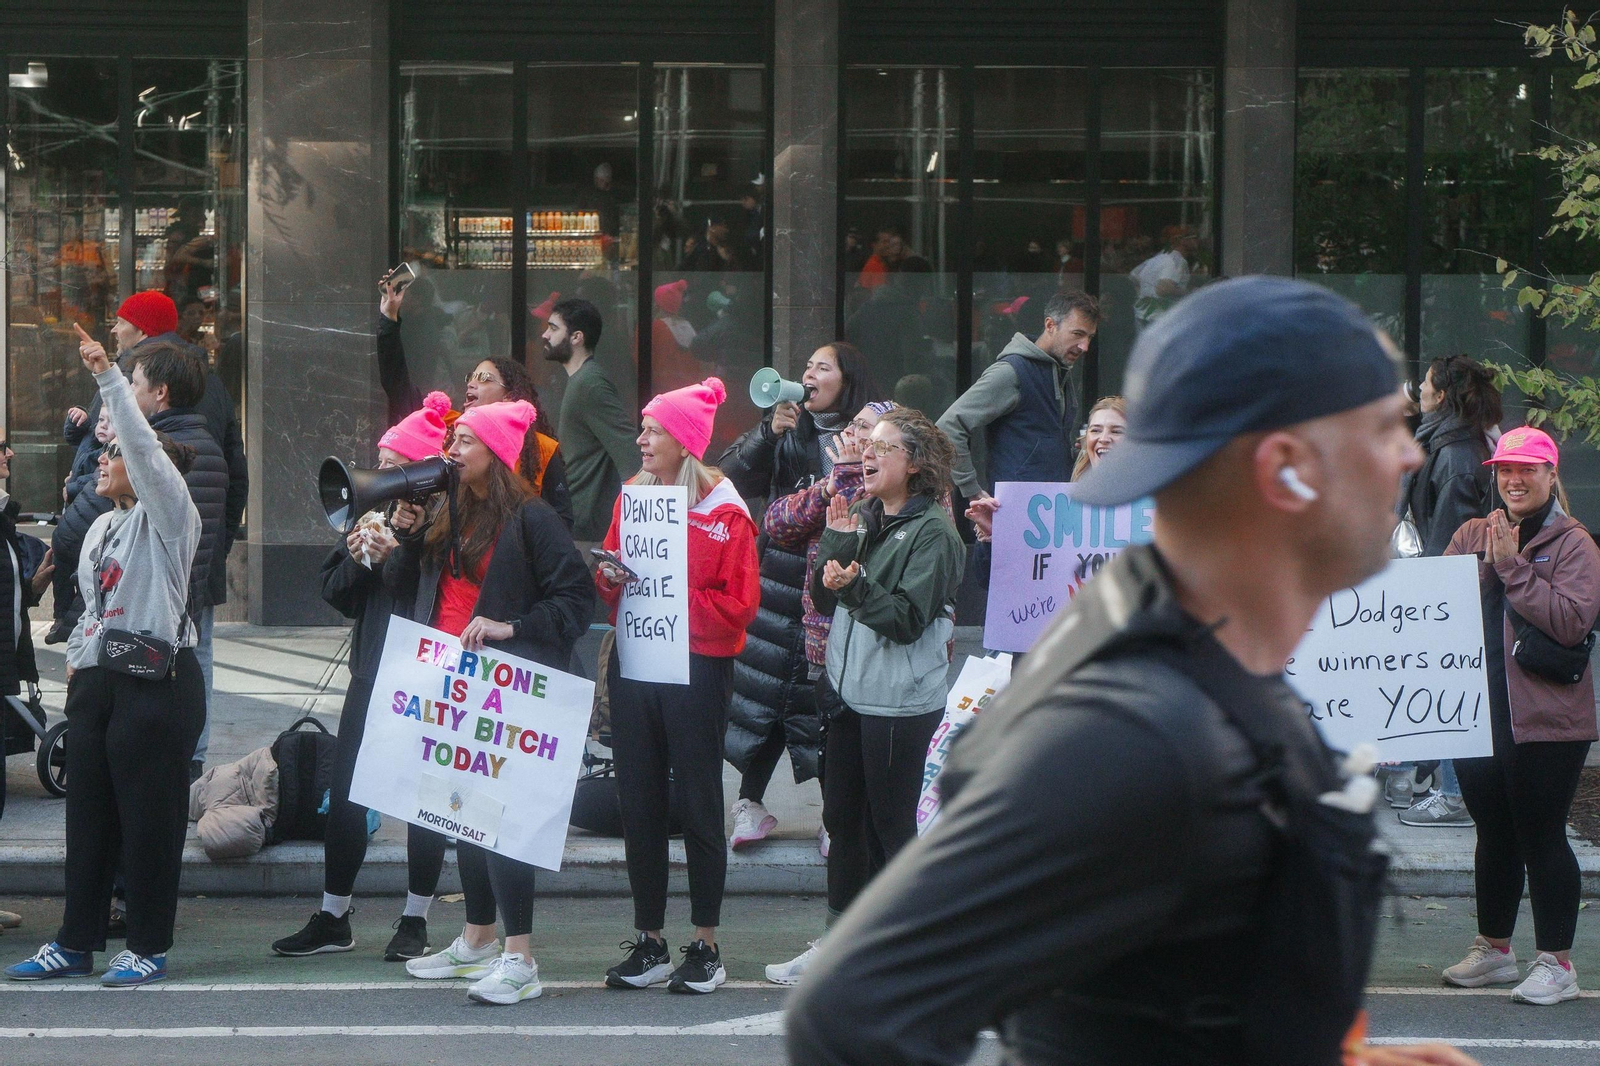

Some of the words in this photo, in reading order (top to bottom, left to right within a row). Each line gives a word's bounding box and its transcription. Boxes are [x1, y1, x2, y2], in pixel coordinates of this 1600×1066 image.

[623, 493, 679, 525] DENISE
[625, 534, 668, 560] CRAIG
[1032, 553, 1051, 580] IF
[625, 611, 677, 642] PEGGY
[1329, 588, 1449, 633] Dodgers
[416, 638, 548, 699] EVERYONE
[1318, 652, 1429, 672] winners
[1440, 646, 1483, 671] and
[443, 675, 468, 703] IS
[482, 688, 502, 714] A
[1378, 684, 1481, 729] YOU!
[392, 690, 468, 732] SALTY
[474, 716, 558, 761] BITCH
[422, 736, 507, 779] TODAY
[417, 809, 461, 834] MORTON
[461, 826, 486, 842] SALT
